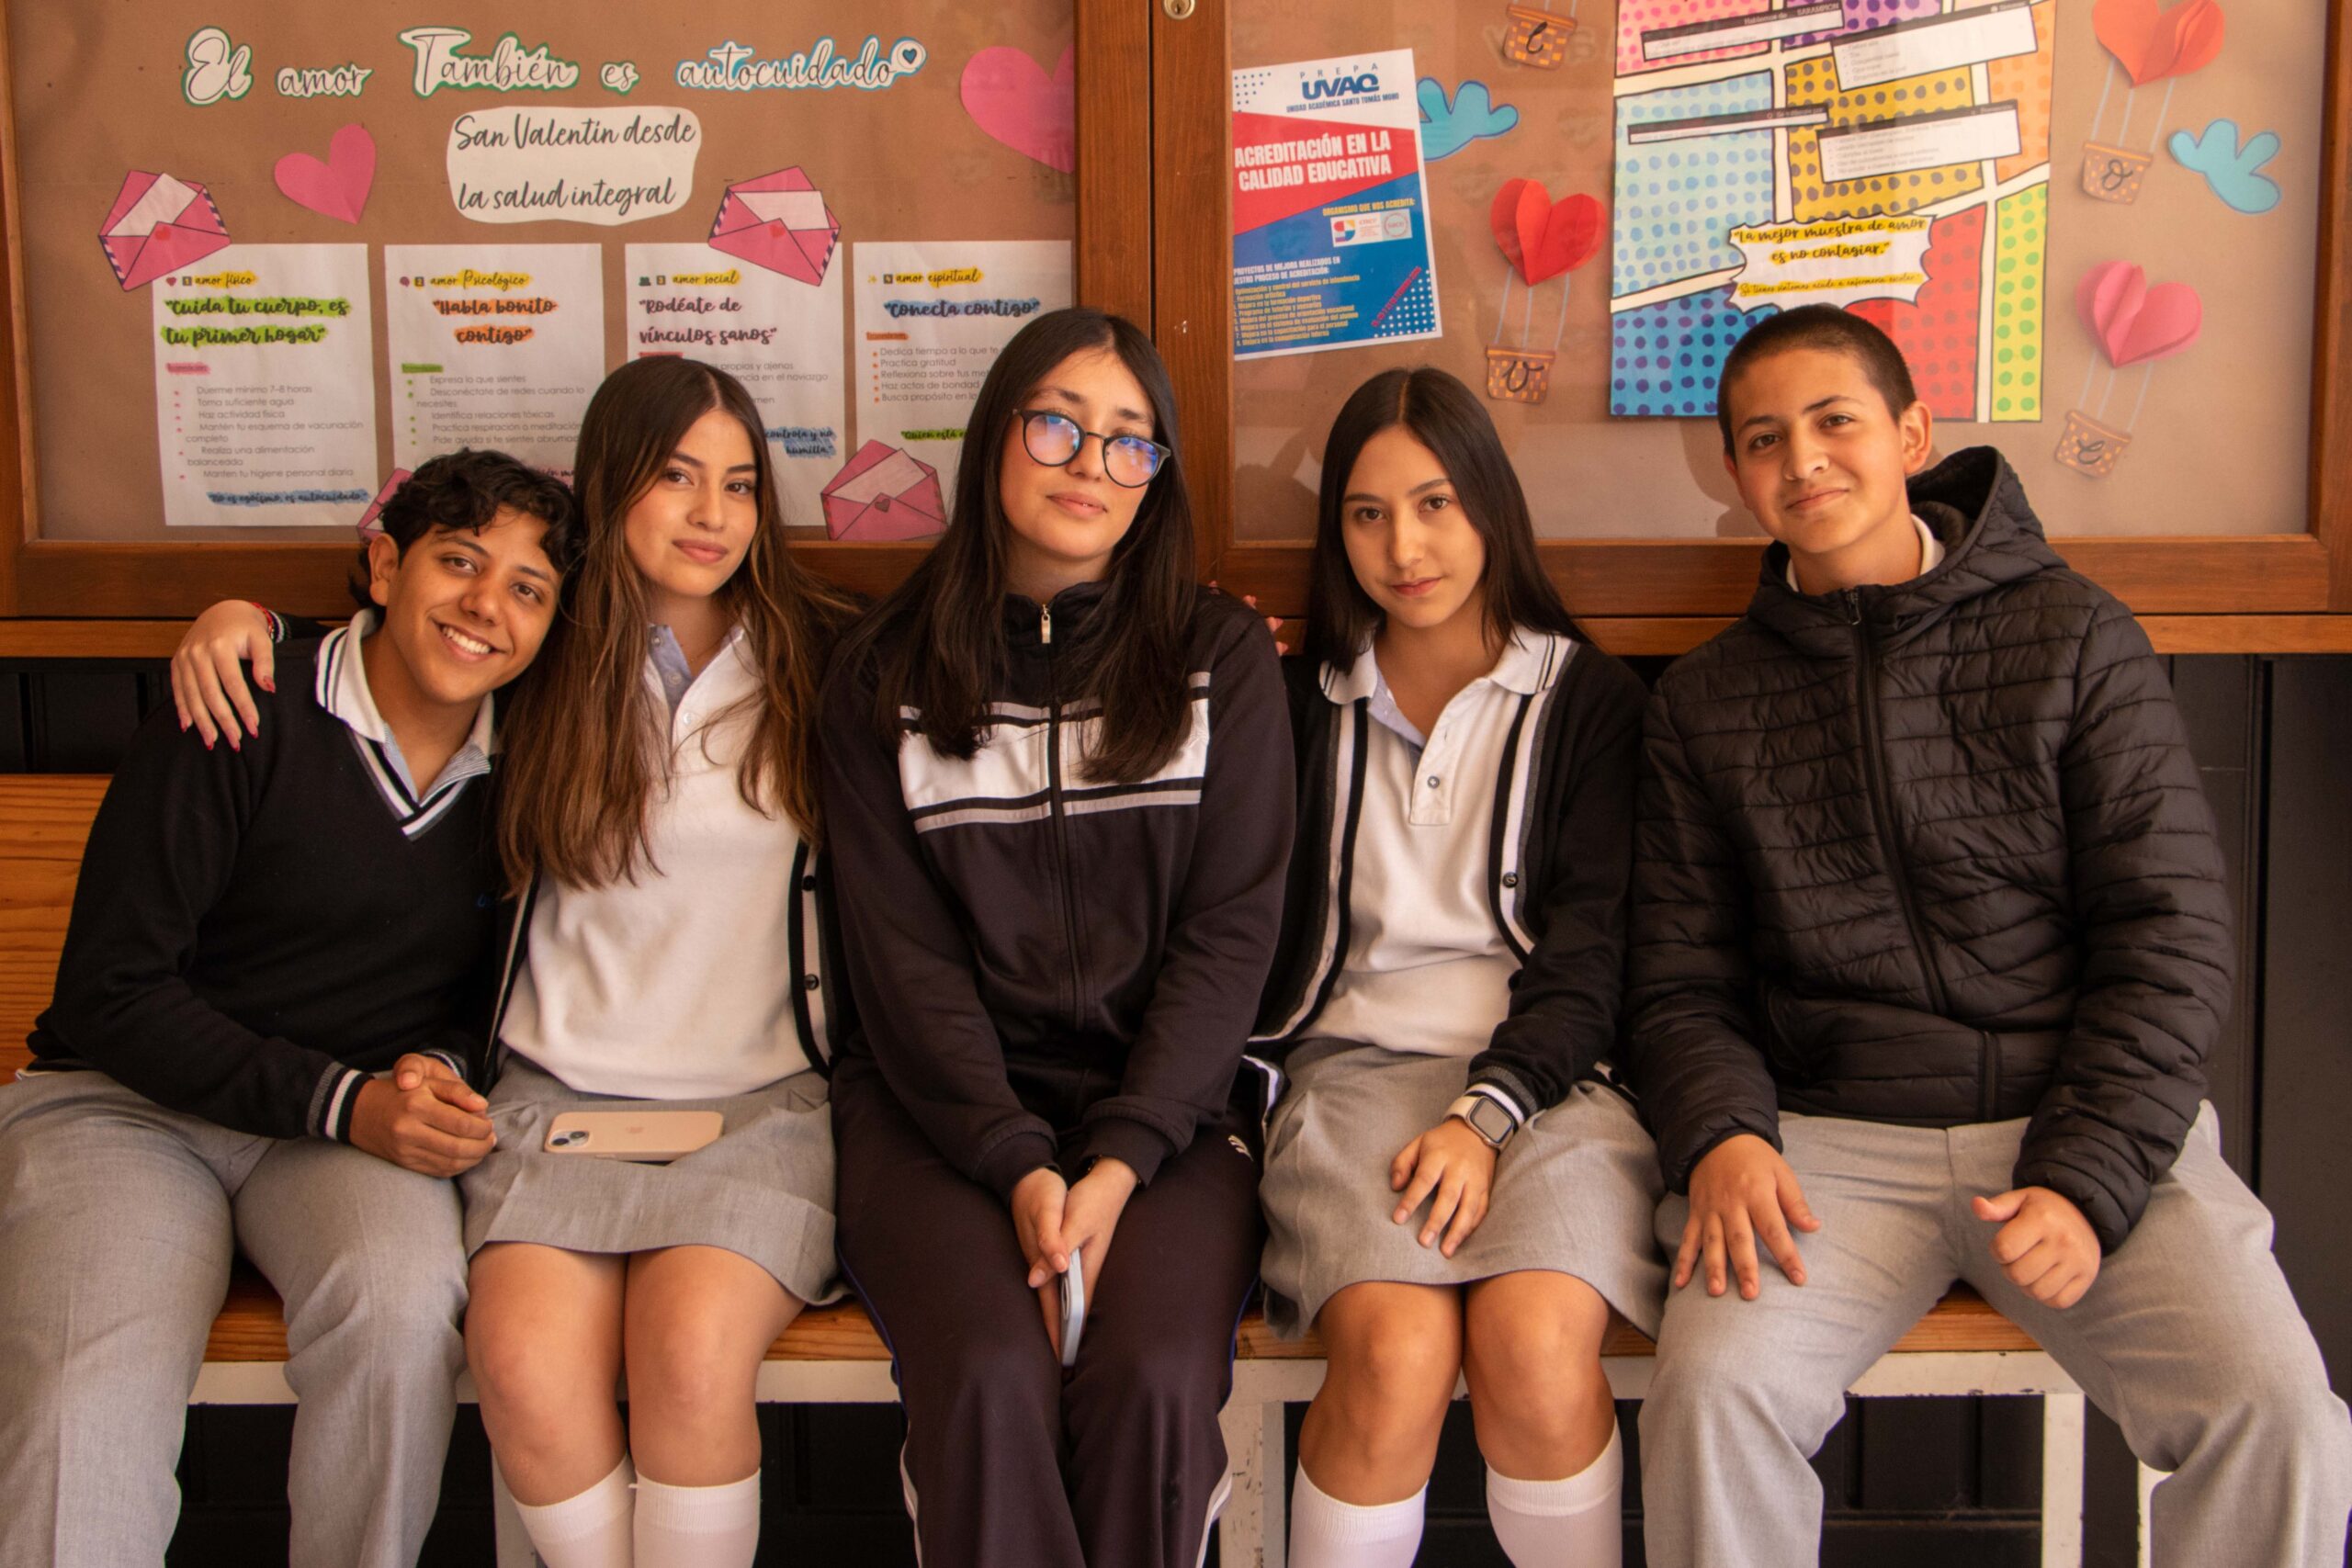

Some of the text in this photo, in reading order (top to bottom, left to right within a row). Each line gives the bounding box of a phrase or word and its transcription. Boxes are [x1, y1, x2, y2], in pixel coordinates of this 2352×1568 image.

[187, 32, 897, 101] El amor También es autocuidado
[1300, 62, 1378, 80] PREPA
[1301, 73, 1380, 101] UVAQ
[456, 116, 509, 151] San
[624, 109, 695, 144] desde
[1234, 130, 1392, 168] ACREDITACIÓN EN LA
[1238, 154, 1392, 192] CALIDAD EDUCATIVA
[459, 176, 676, 218] la salud integral
[1758, 227, 1799, 244] mejor
[1804, 222, 1864, 239] muestra
[1867, 220, 1884, 231] de
[1888, 218, 1927, 229] amor
[1770, 252, 1786, 264] es
[1790, 249, 1807, 260] no
[195, 276, 222, 285] amor
[430, 269, 527, 291] amor Psicológico
[673, 270, 738, 285] amor social
[896, 268, 979, 287] amor espiritual
[227, 295, 251, 314] tu
[254, 297, 323, 316] cuerpo,
[328, 300, 349, 316] es
[433, 297, 558, 315] "Habla bonito
[718, 296, 741, 312] de
[166, 327, 188, 344] tu
[191, 327, 261, 347] primer
[639, 326, 715, 345] vínculos
[880, 346, 913, 356] Dedica
[915, 346, 948, 356] tiempo
[959, 346, 967, 355] lo
[968, 347, 985, 356] que
[989, 346, 998, 355] te
[720, 362, 753, 371] propios
[763, 361, 794, 372] ajenos
[880, 358, 956, 368] Practica gratitud
[786, 373, 829, 383] noviazgo
[881, 369, 927, 378] Reflexiona
[929, 369, 955, 378] sobre
[956, 369, 969, 378] tus
[430, 375, 526, 386] Expresa lo que sientes
[881, 380, 979, 390] Haz actos de bondad
[197, 385, 232, 395] Duerme
[287, 385, 312, 394] horas
[430, 386, 585, 397] Desconéctate de redes cuando lo
[198, 397, 294, 408] Toma suficiente agua
[882, 393, 909, 402] Busca
[910, 392, 953, 402] propósito
[955, 393, 967, 401] en
[416, 399, 458, 409] necesites
[198, 410, 214, 419] Haz
[217, 410, 260, 419] actividad
[431, 409, 554, 421] Identifica relaciones tóxicas
[237, 423, 245, 431] tu
[248, 423, 290, 434] esquema
[292, 422, 305, 431] de
[308, 420, 364, 430] vacunación
[433, 423, 469, 432] Practica
[471, 422, 519, 434] respiración
[186, 434, 228, 446] completo
[433, 435, 452, 445] Pide
[455, 435, 483, 446] ayuda
[485, 435, 492, 444] si
[493, 435, 503, 444] te
[505, 434, 535, 445] sientes
[201, 445, 315, 455] Realiza una alimentación
[187, 457, 243, 467] balanceada
[250, 468, 285, 480] higiene
[286, 468, 325, 479] personal
[328, 468, 354, 478] diaria
